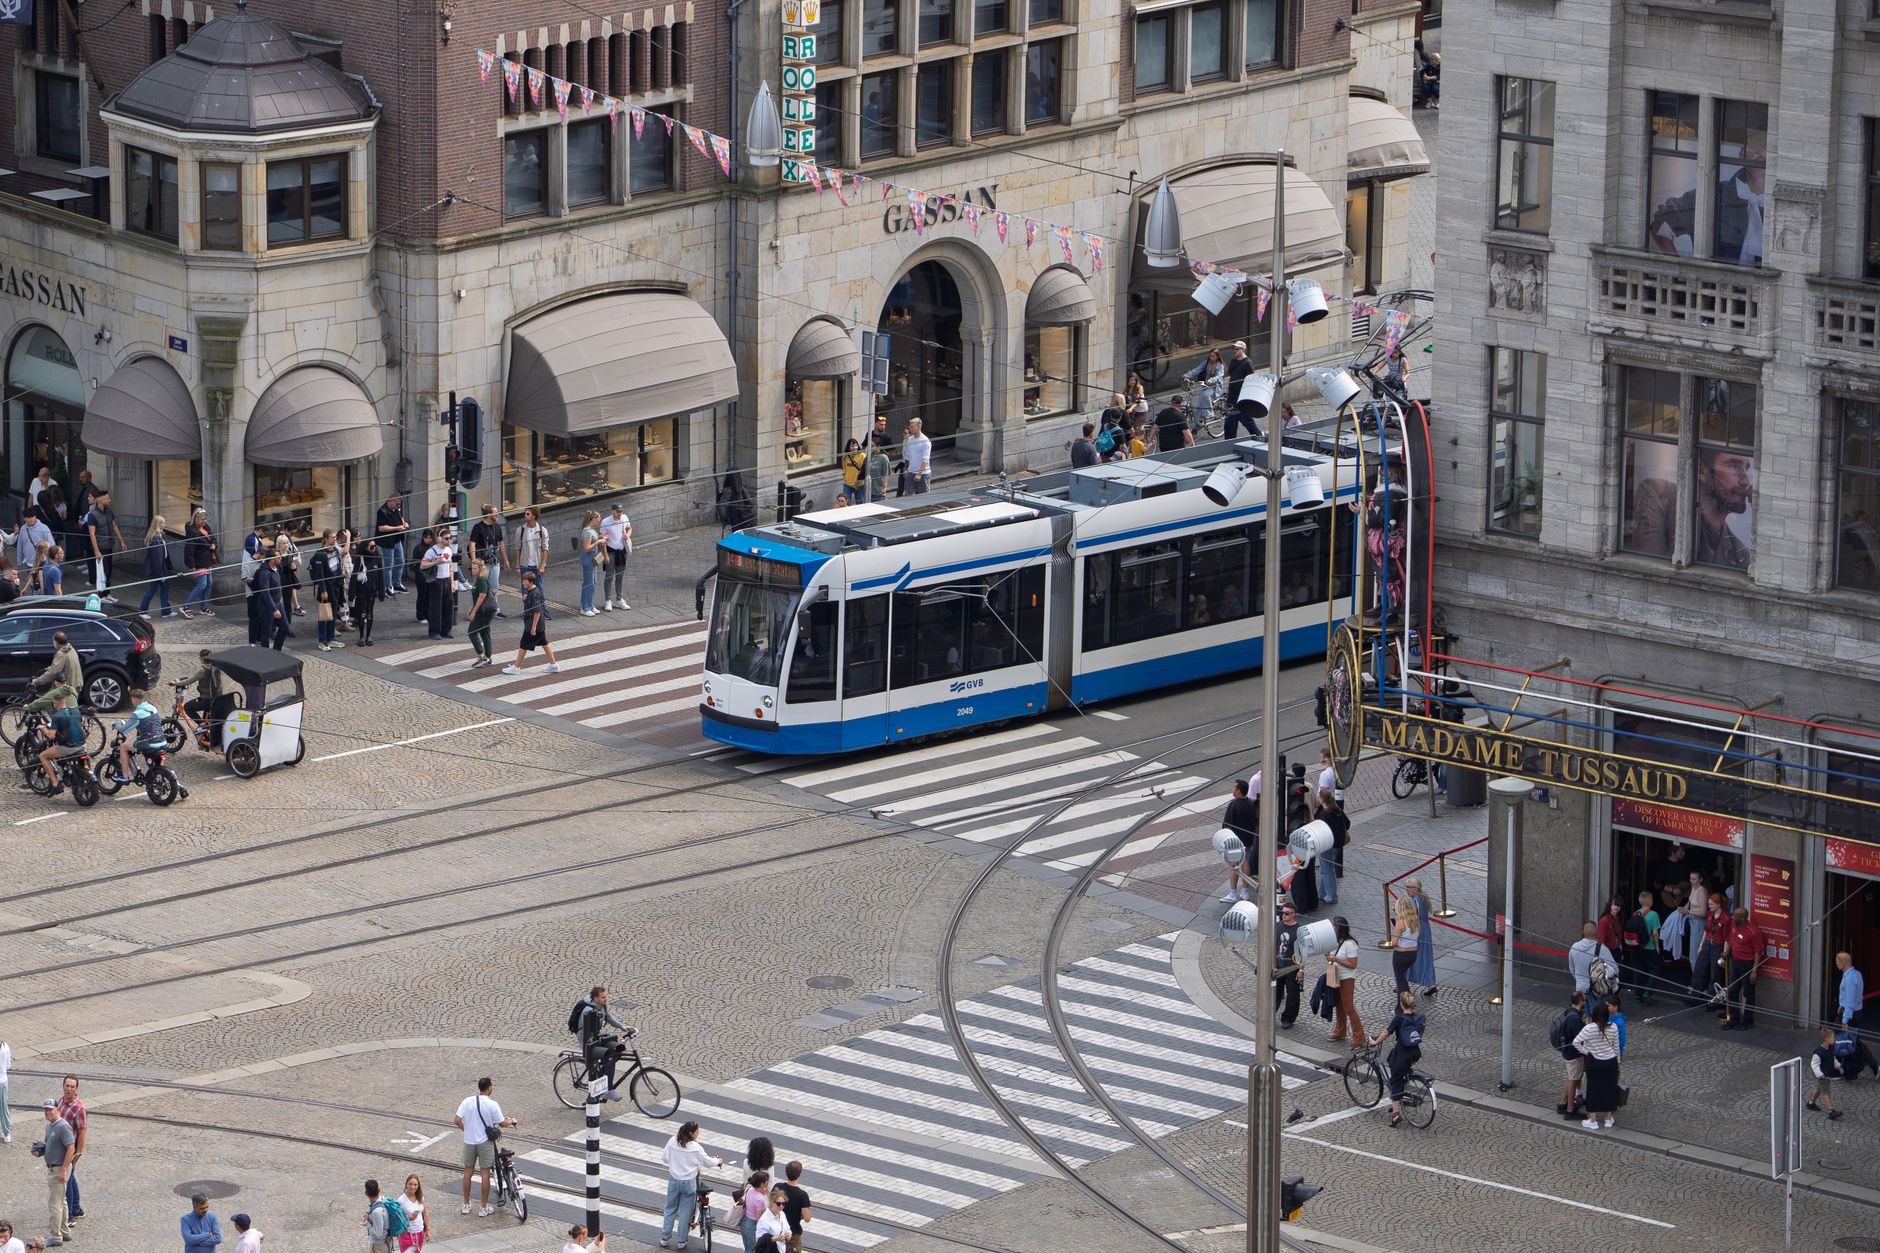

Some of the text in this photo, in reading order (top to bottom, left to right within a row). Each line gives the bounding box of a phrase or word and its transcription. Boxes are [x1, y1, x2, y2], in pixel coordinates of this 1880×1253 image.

[783, 36, 799, 183] ROLEX
[966, 679, 984, 689] GVB
[956, 706, 974, 716] 2049
[1381, 718, 1687, 801] MADAME TUSSAUD
[1634, 804, 1722, 828] DISCOVER A WORLD
[1641, 815, 1714, 836] OF FAMOUS FUN
